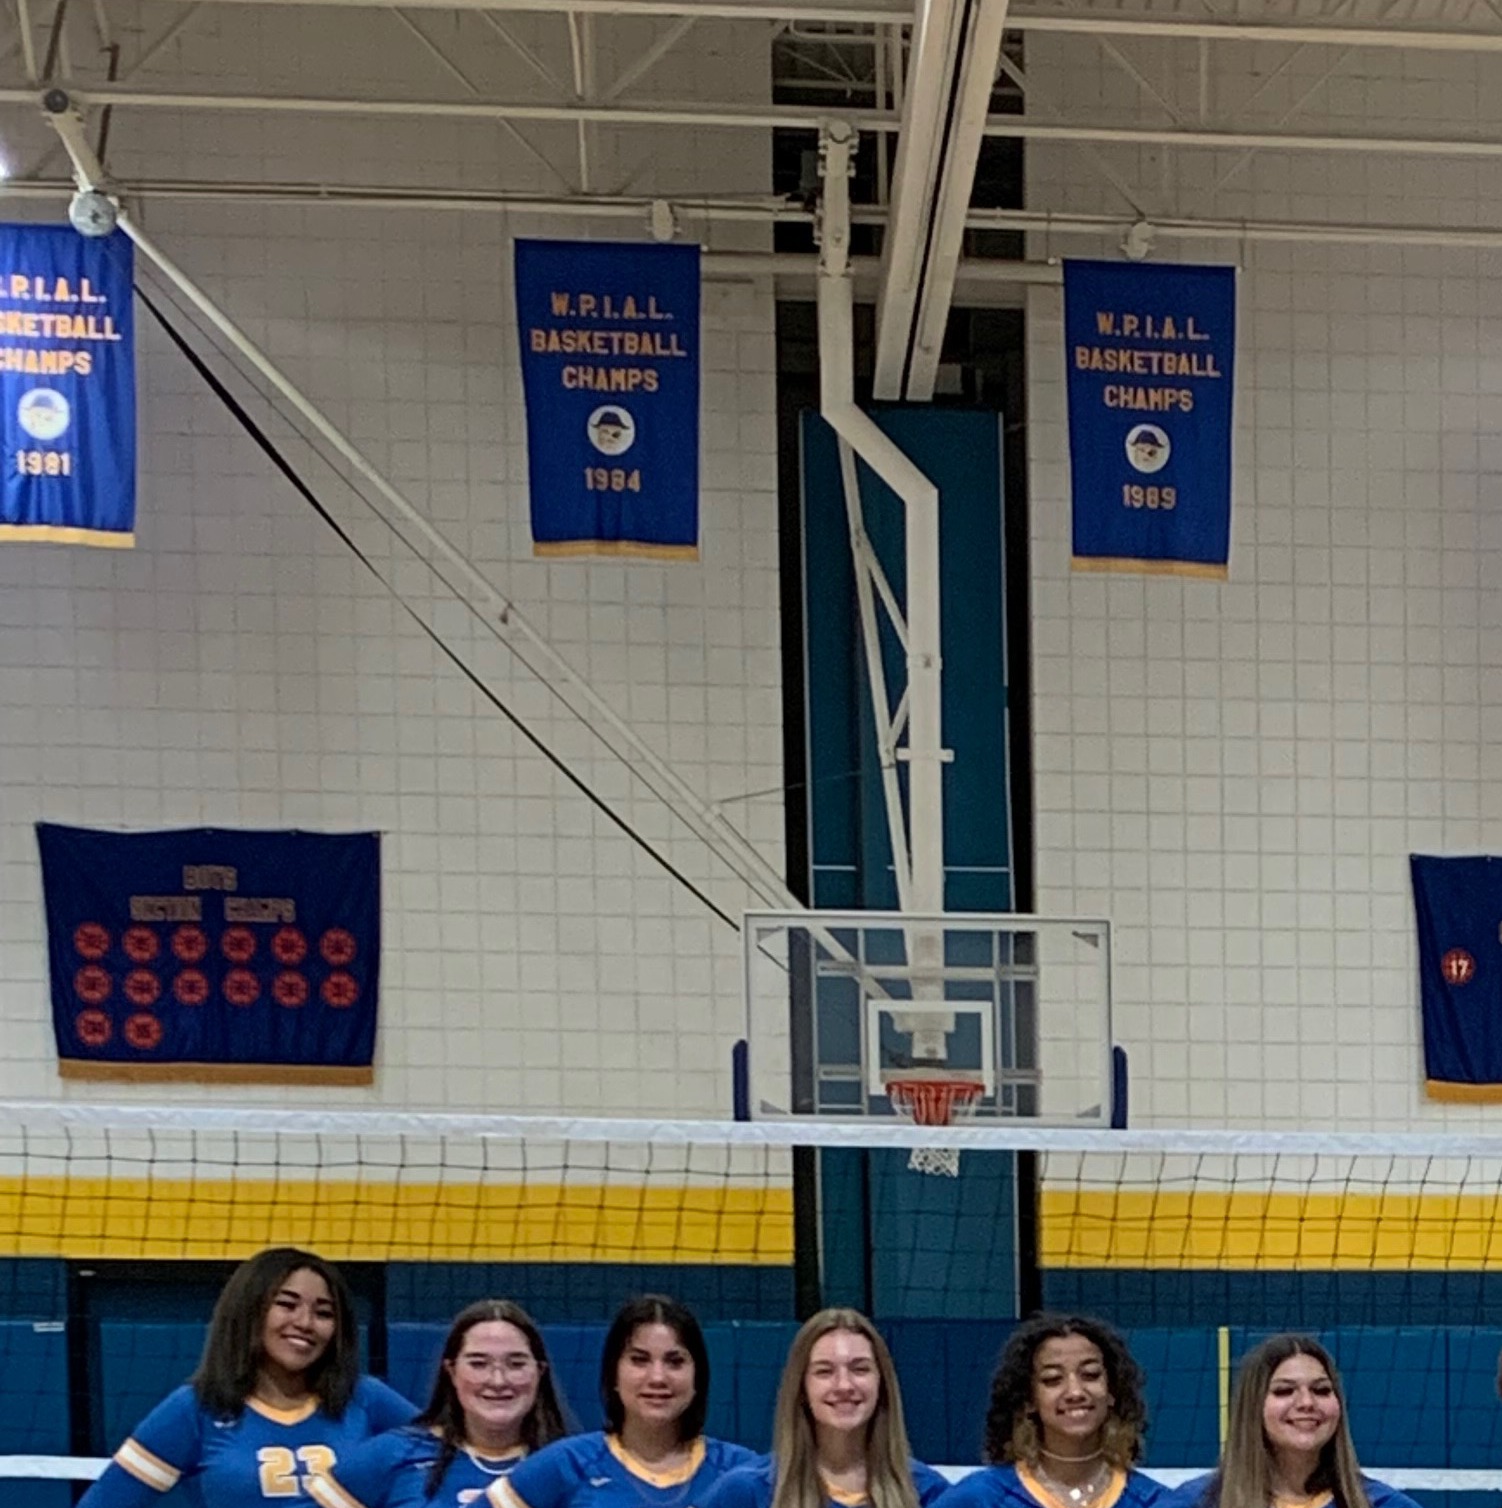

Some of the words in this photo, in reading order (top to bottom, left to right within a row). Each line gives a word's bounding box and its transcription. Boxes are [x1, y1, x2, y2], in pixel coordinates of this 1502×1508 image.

[0, 274, 107, 303] .P.I.A.L.
[551, 291, 675, 321] W.P.I.A.L.
[1096, 311, 1211, 341] W.P.I.A.L.
[530, 328, 688, 358] BASKETBALL
[1075, 346, 1222, 379] BASKETBALL
[562, 365, 660, 392] CHAMPS
[1103, 384, 1194, 413] CHAMPS
[16, 450, 71, 477] 1981
[584, 467, 642, 493] 1984
[1450, 959, 1469, 979] 17
